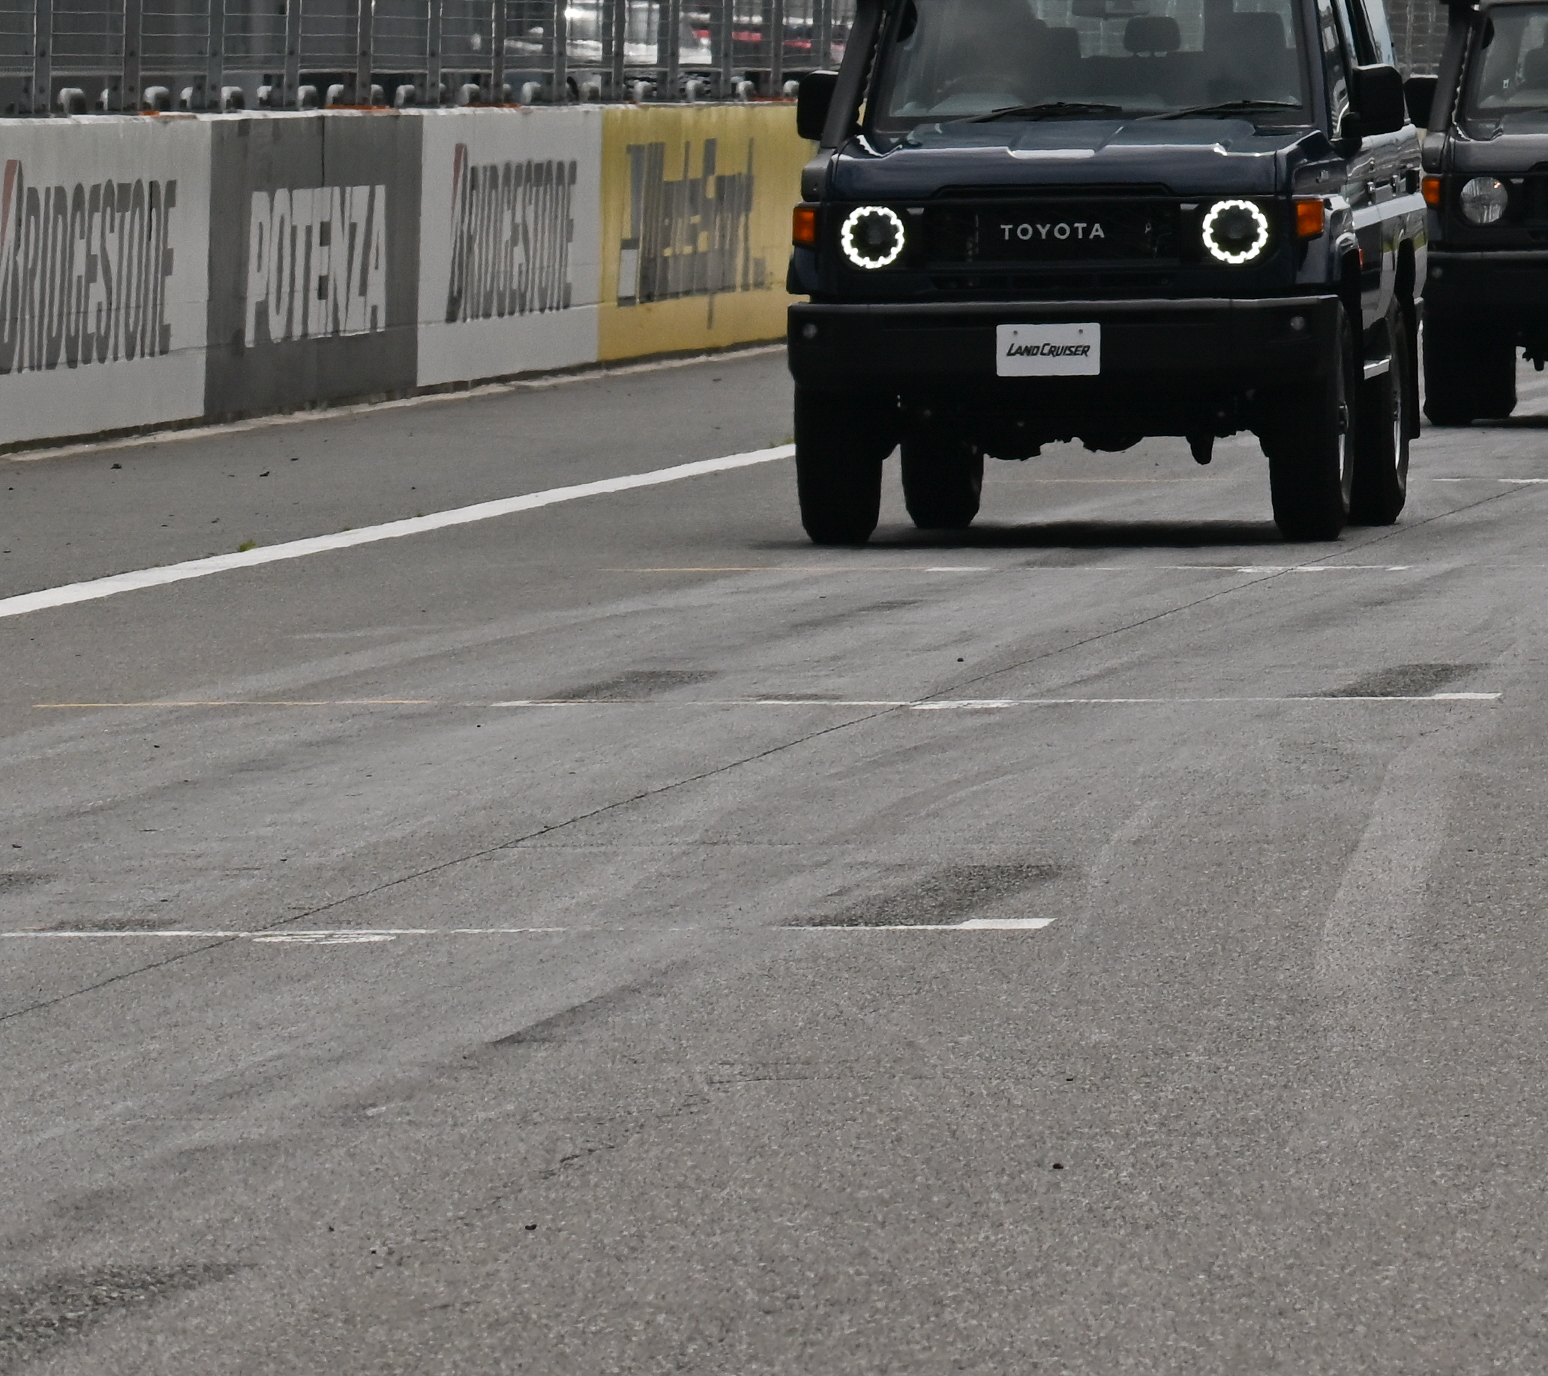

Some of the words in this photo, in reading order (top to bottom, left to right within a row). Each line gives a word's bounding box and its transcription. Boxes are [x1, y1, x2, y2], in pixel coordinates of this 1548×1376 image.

[0, 159, 177, 374] BRIDGESTONE
[244, 184, 388, 347] POTENZA
[446, 142, 578, 323] BRIDGESTONE
[1000, 223, 1105, 241] TOYOTA
